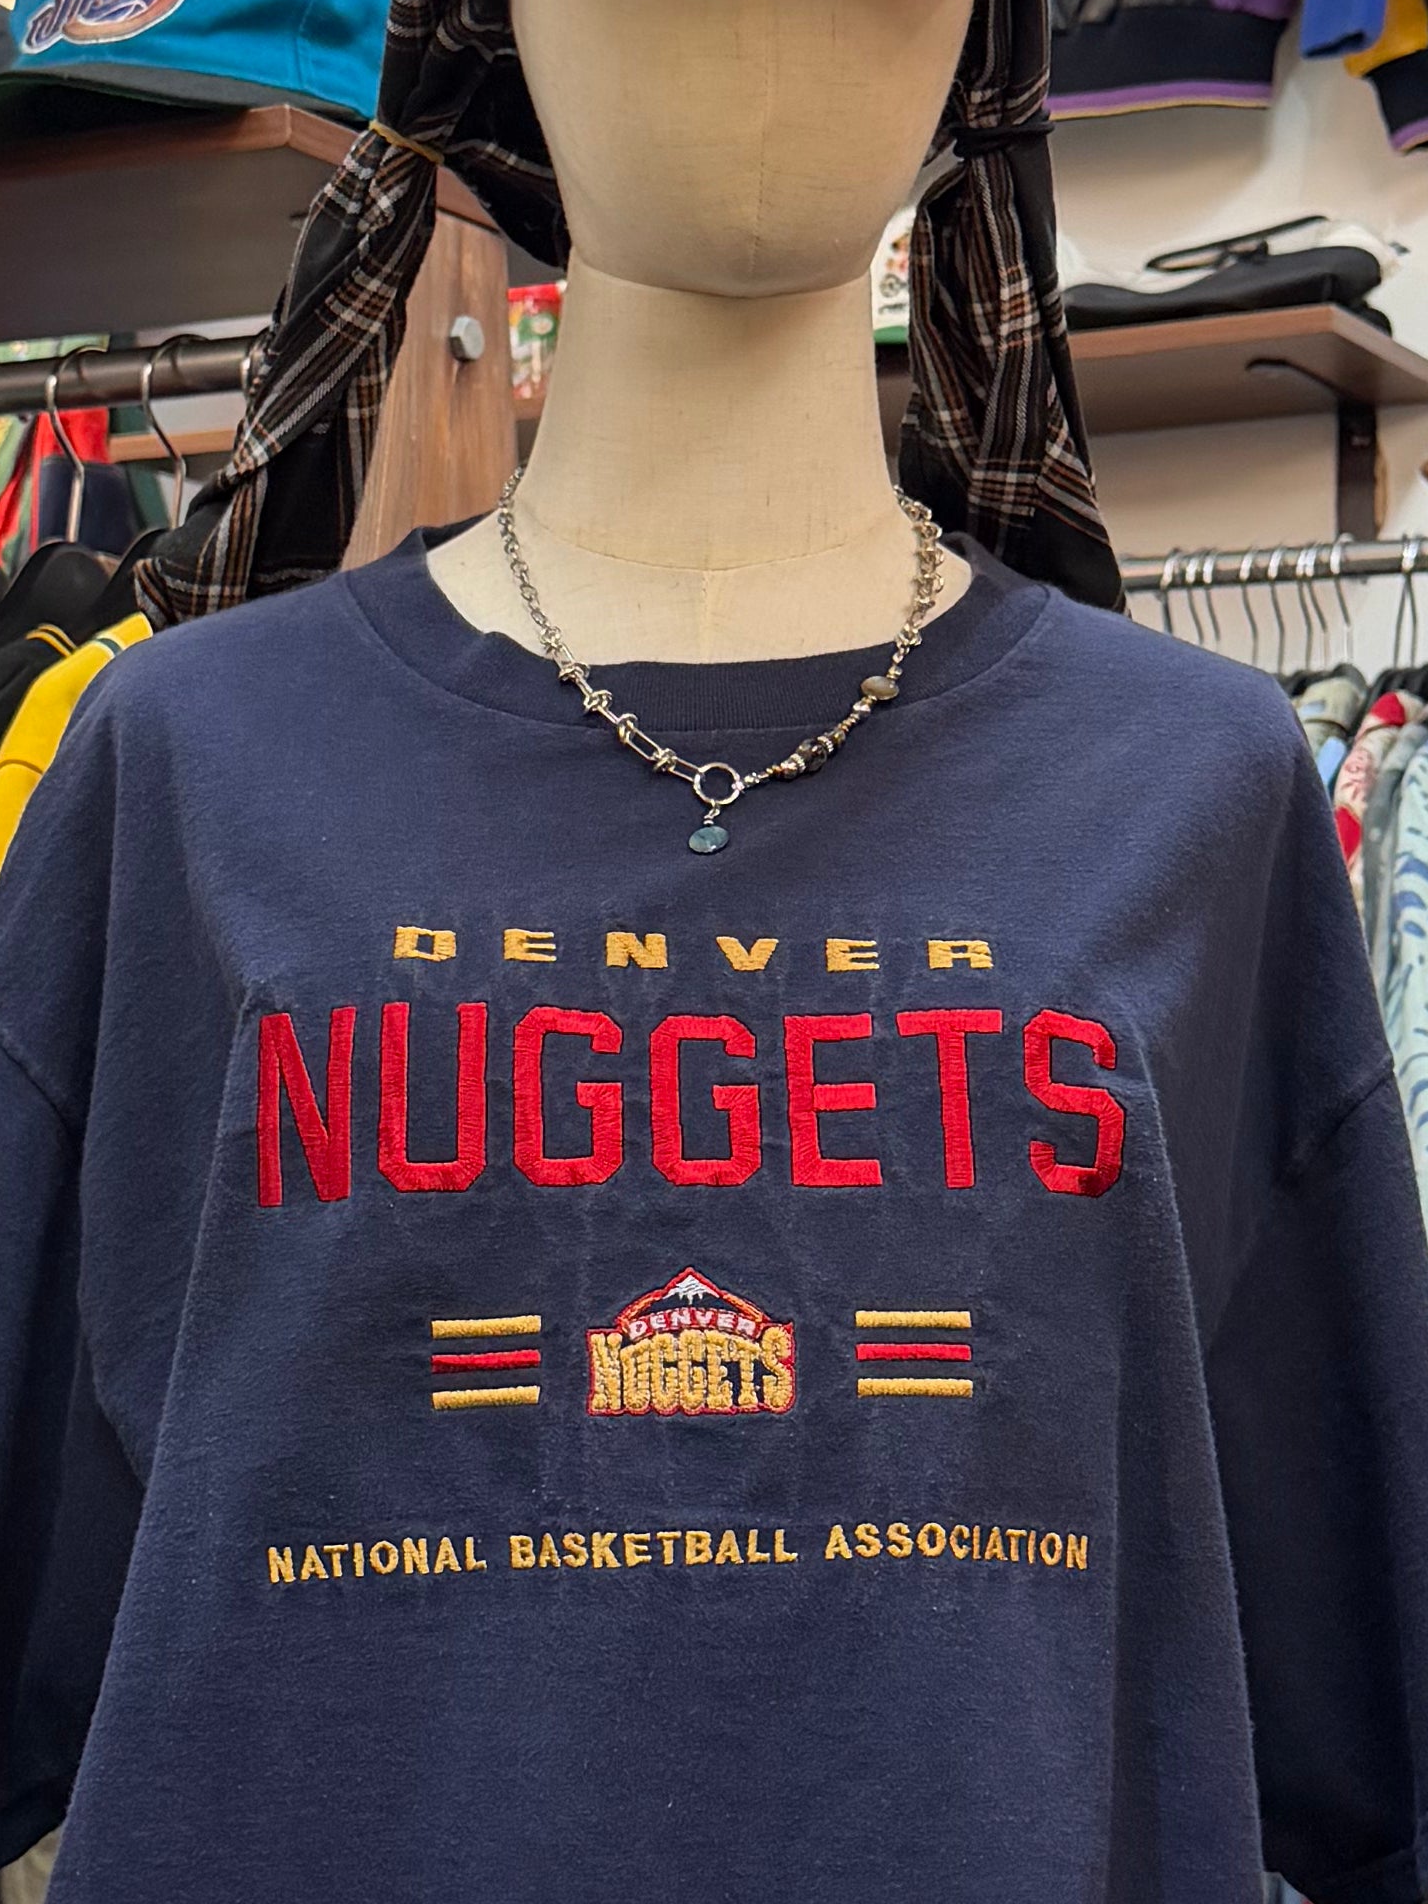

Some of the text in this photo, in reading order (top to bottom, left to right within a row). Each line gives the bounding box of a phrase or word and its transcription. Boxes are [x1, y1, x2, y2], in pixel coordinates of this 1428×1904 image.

[394, 925, 995, 973] DENVER
[256, 1002, 1127, 1208] NUGGETS
[628, 1306, 759, 1341] DENVER
[589, 1325, 795, 1412] NUGGETS
[267, 1522, 1090, 1587] NATIONAL BASKETBALL ASSOCIATION
